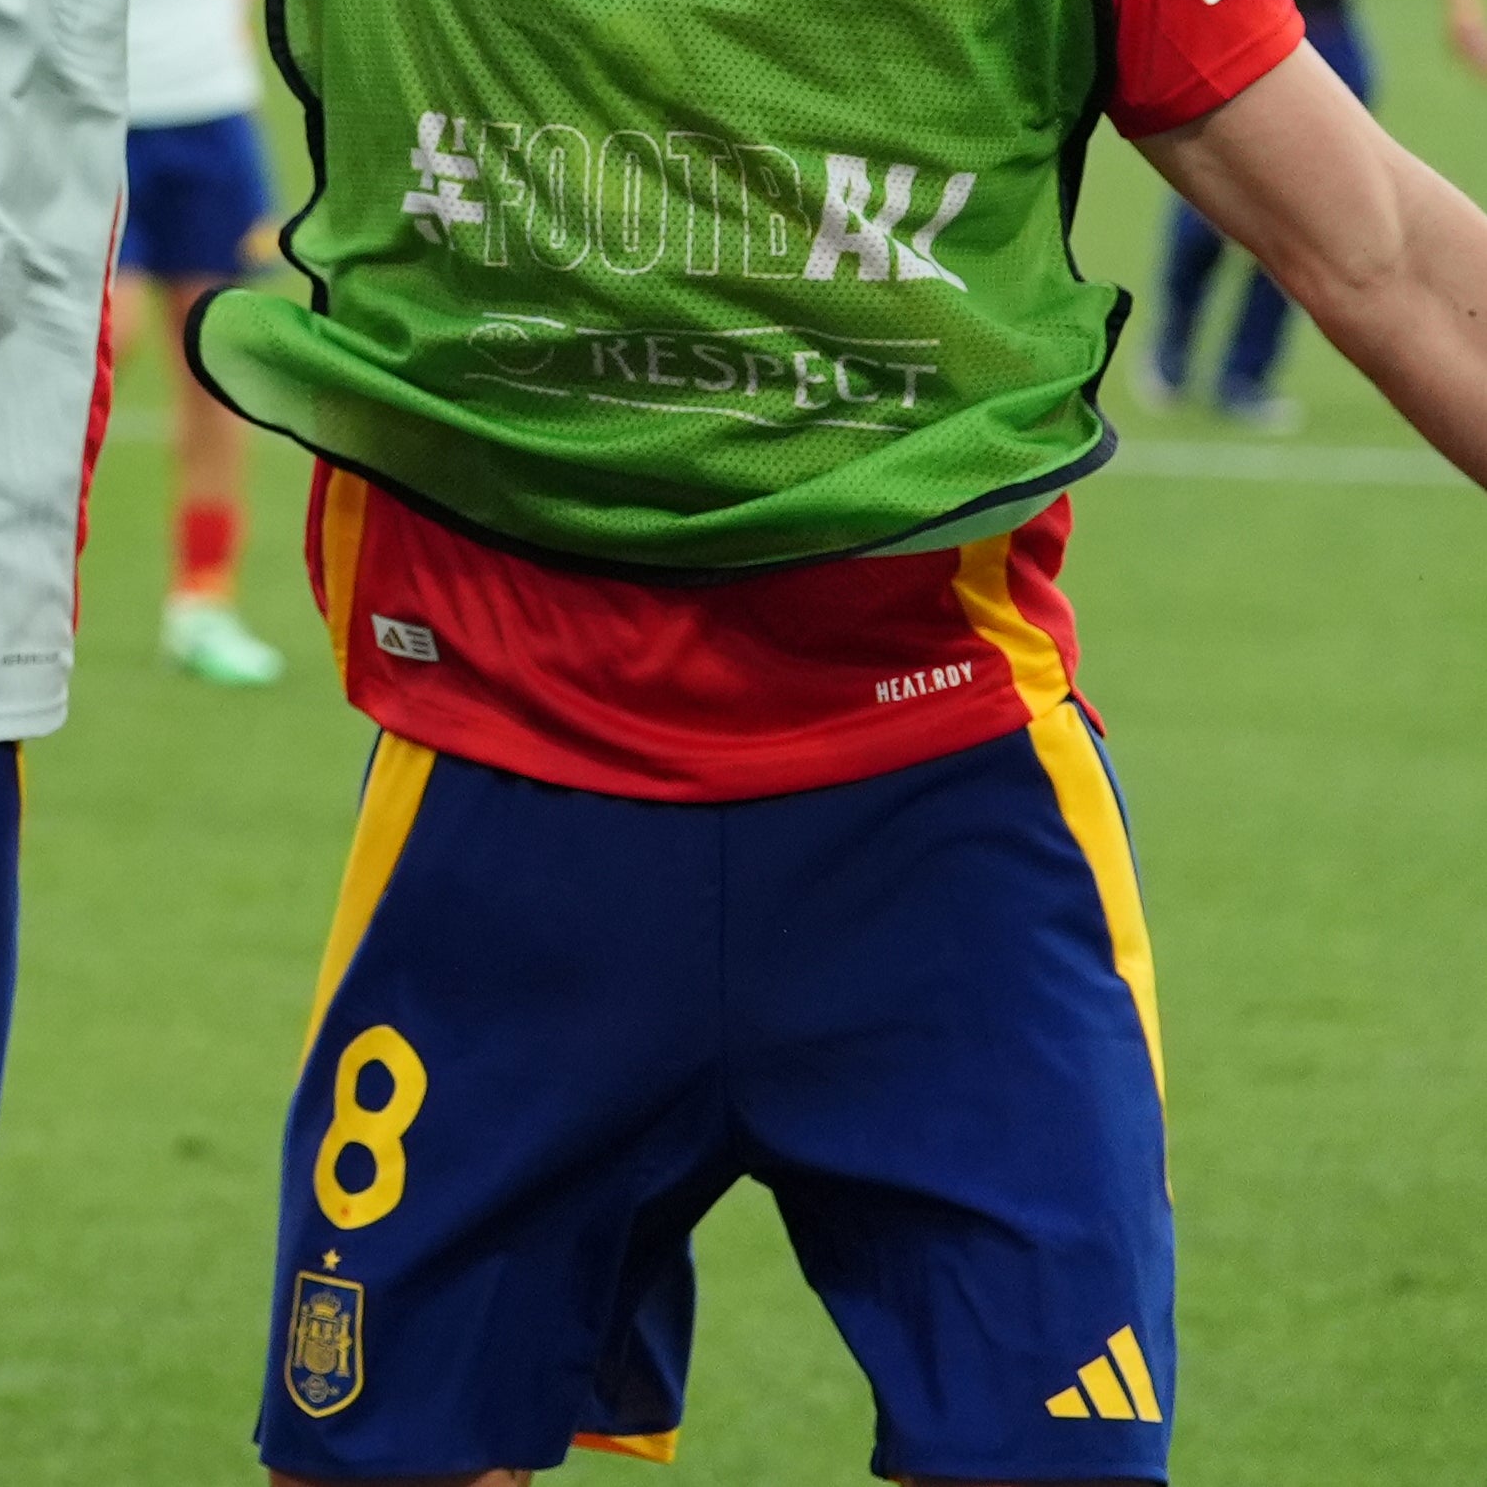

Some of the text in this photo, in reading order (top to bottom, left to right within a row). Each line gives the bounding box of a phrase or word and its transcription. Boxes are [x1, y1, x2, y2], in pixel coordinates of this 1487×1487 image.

[592, 334, 937, 409] RESPECT
[875, 660, 973, 703] HEAT.RDY
[313, 1024, 428, 1230] 8
